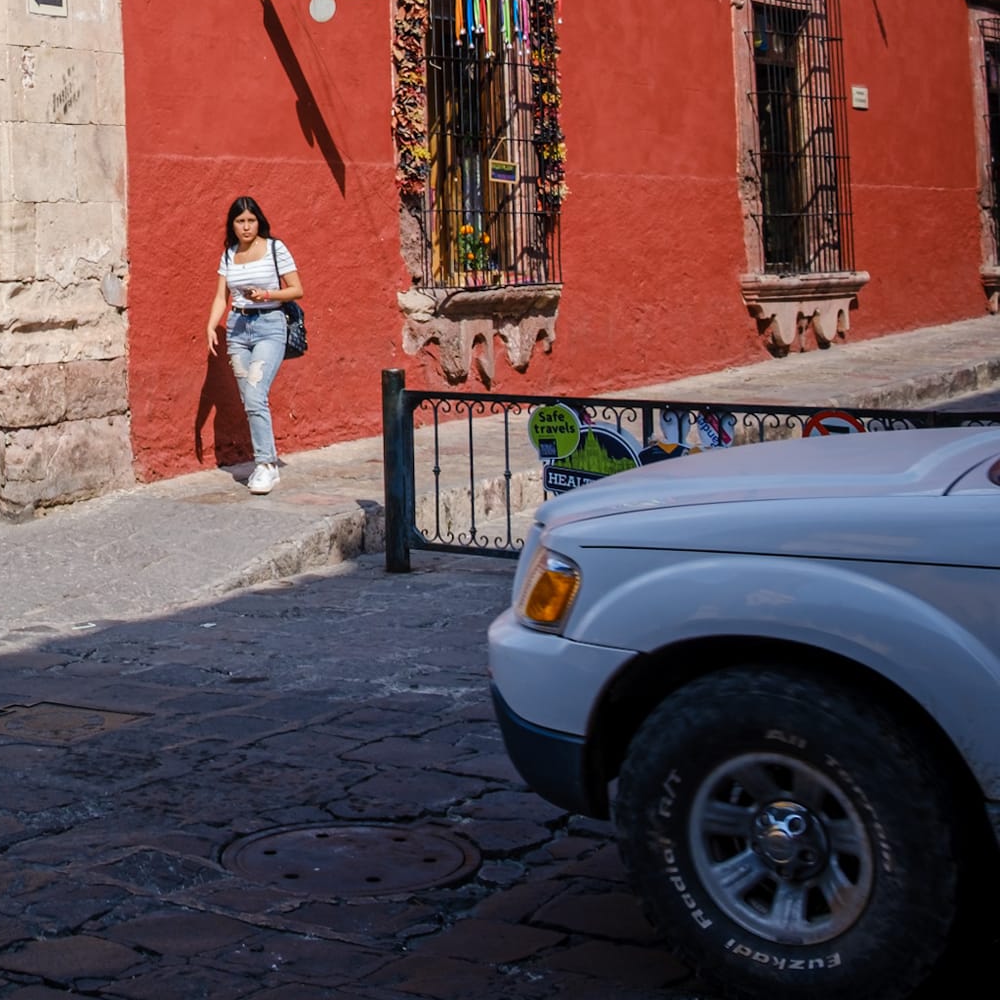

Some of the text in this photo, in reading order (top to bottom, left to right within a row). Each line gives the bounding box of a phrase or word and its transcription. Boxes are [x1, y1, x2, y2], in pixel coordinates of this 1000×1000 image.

[538, 410, 565, 422] Safe
[534, 422, 575, 434] travels
[659, 836, 714, 931] Radial
[723, 937, 842, 971] Euzkadi
